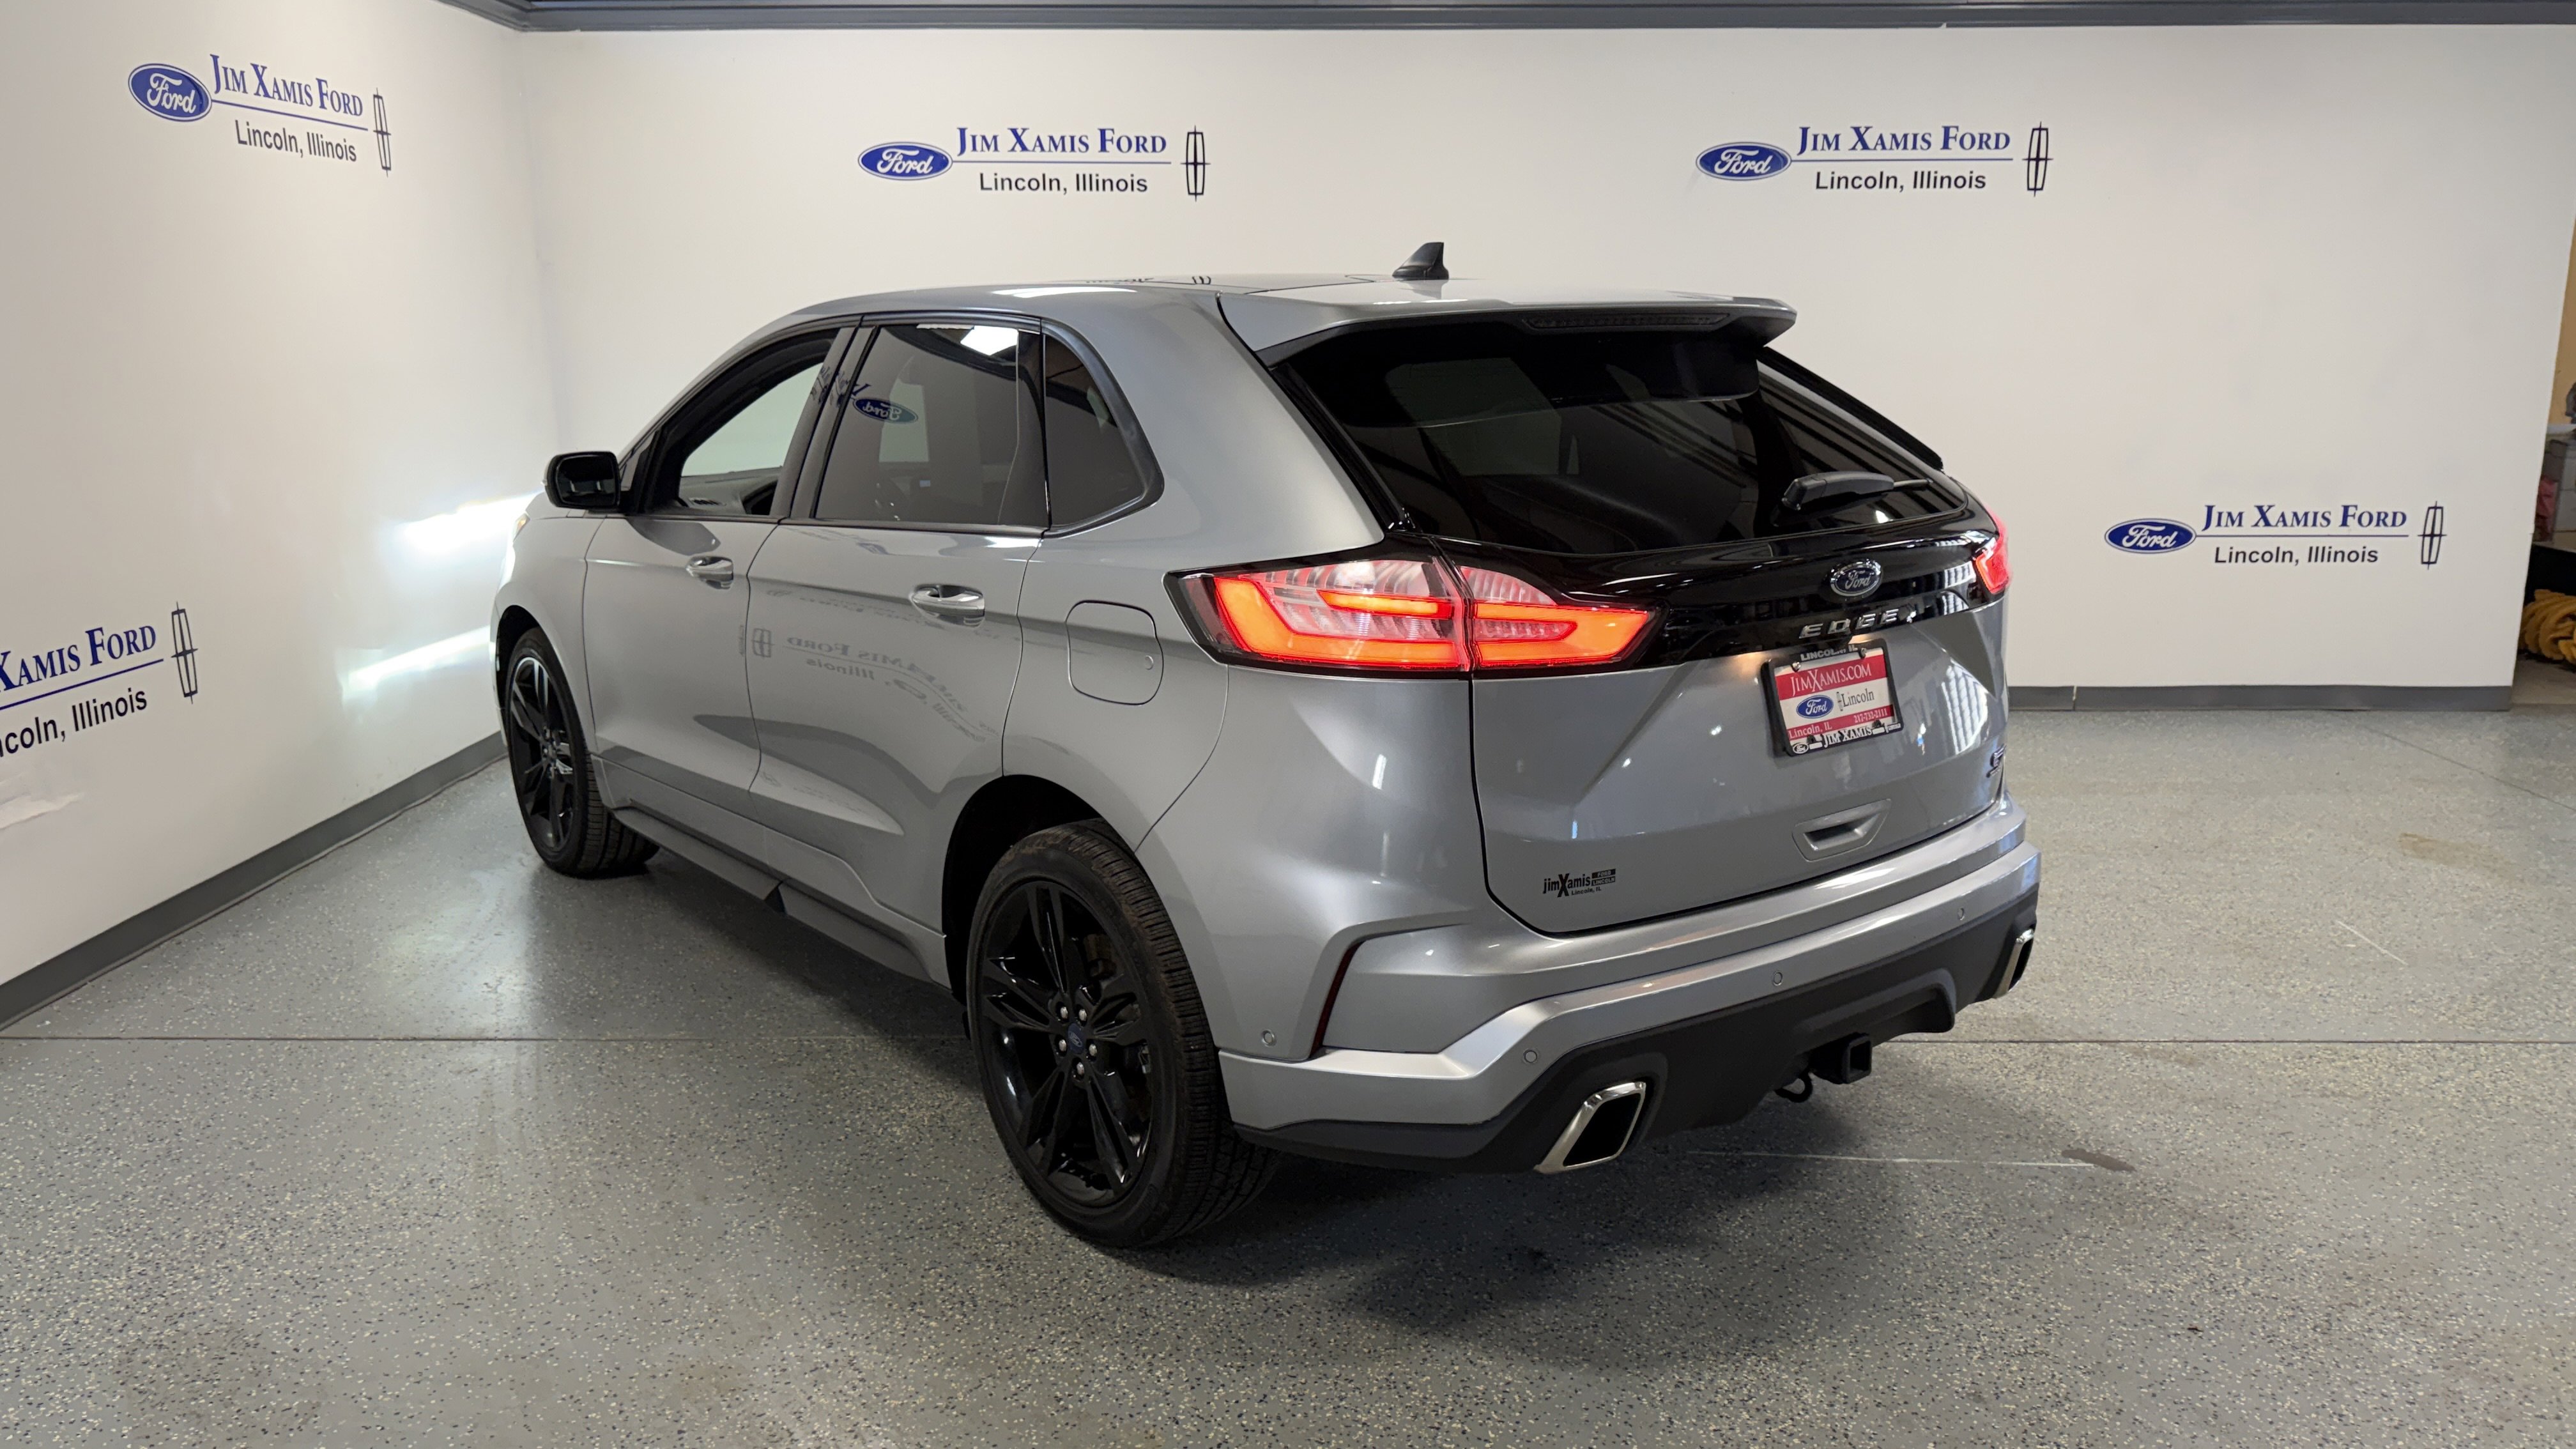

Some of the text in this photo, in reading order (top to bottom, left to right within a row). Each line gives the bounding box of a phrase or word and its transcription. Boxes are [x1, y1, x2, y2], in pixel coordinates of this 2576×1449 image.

[146, 72, 196, 114] Ford
[210, 54, 364, 117] JIM XAMIS FORD
[234, 119, 357, 162] Lincoln, Illinois
[956, 128, 1167, 157] JIM XAMIS FORD
[1797, 125, 2011, 156] JIM XAMIS FORD
[876, 148, 935, 176] Ford
[1713, 148, 1772, 175] Ford
[979, 173, 1148, 195] Lincoln, Illinois
[1815, 171, 1987, 193] Lincoln, Illinois
[2201, 504, 2407, 532] JIM XAMIS FORD
[2120, 524, 2177, 549] Ford
[2214, 546, 2379, 566] Lincoln, Illinois
[1844, 569, 1872, 590] Ford
[1798, 608, 1899, 639] EDGE
[85, 625, 157, 666] FORD
[72, 687, 148, 732] Illinois
[1805, 687, 1875, 716] Ford Lincoln
[1821, 733, 1841, 748] JIM
